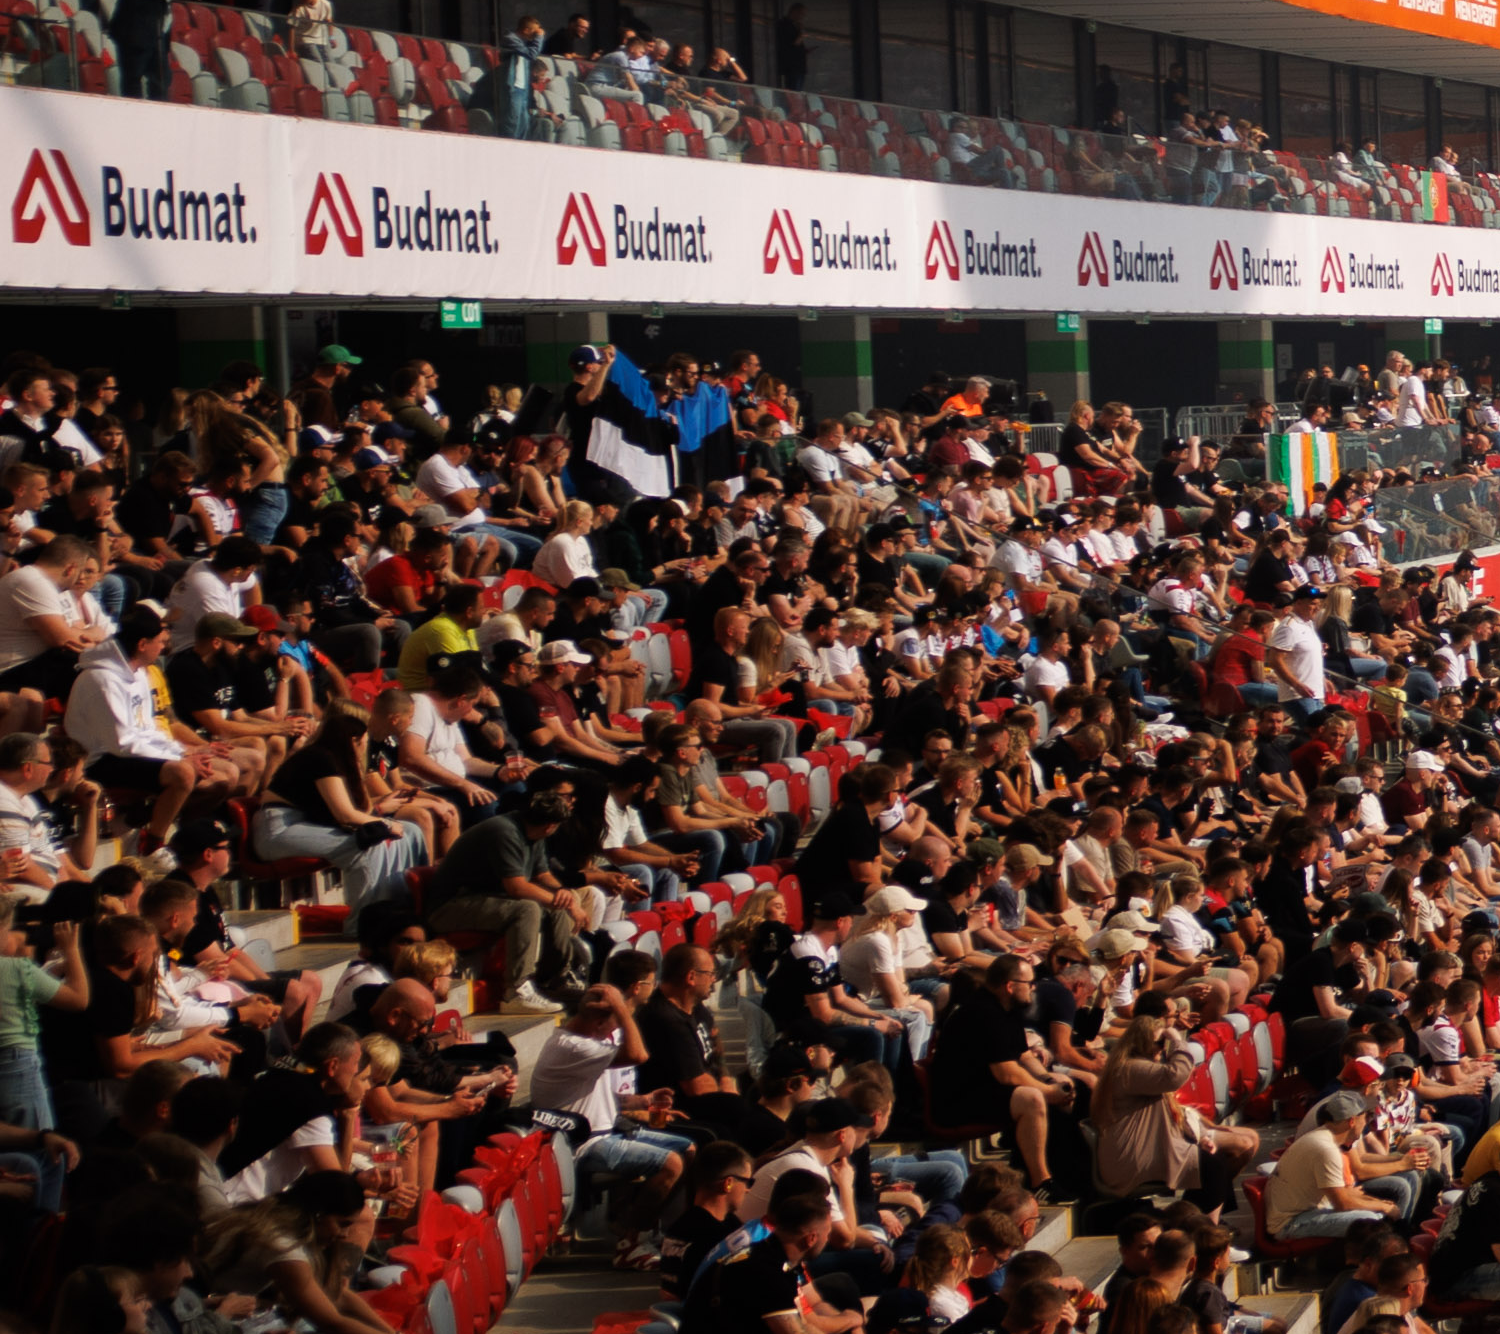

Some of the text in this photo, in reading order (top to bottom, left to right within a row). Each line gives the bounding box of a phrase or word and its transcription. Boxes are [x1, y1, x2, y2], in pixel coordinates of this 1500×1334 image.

[1471, 2, 1498, 27] EXPERT
[102, 166, 256, 243] Budmat.
[373, 187, 498, 254] Budmat.
[615, 205, 711, 263] Budmat.
[811, 220, 896, 270] Budmat.
[965, 235, 1043, 279] Budmat.
[1114, 240, 1178, 282] Budmat.
[1242, 249, 1301, 288] Budmat.
[1350, 253, 1403, 289] Budmat.
